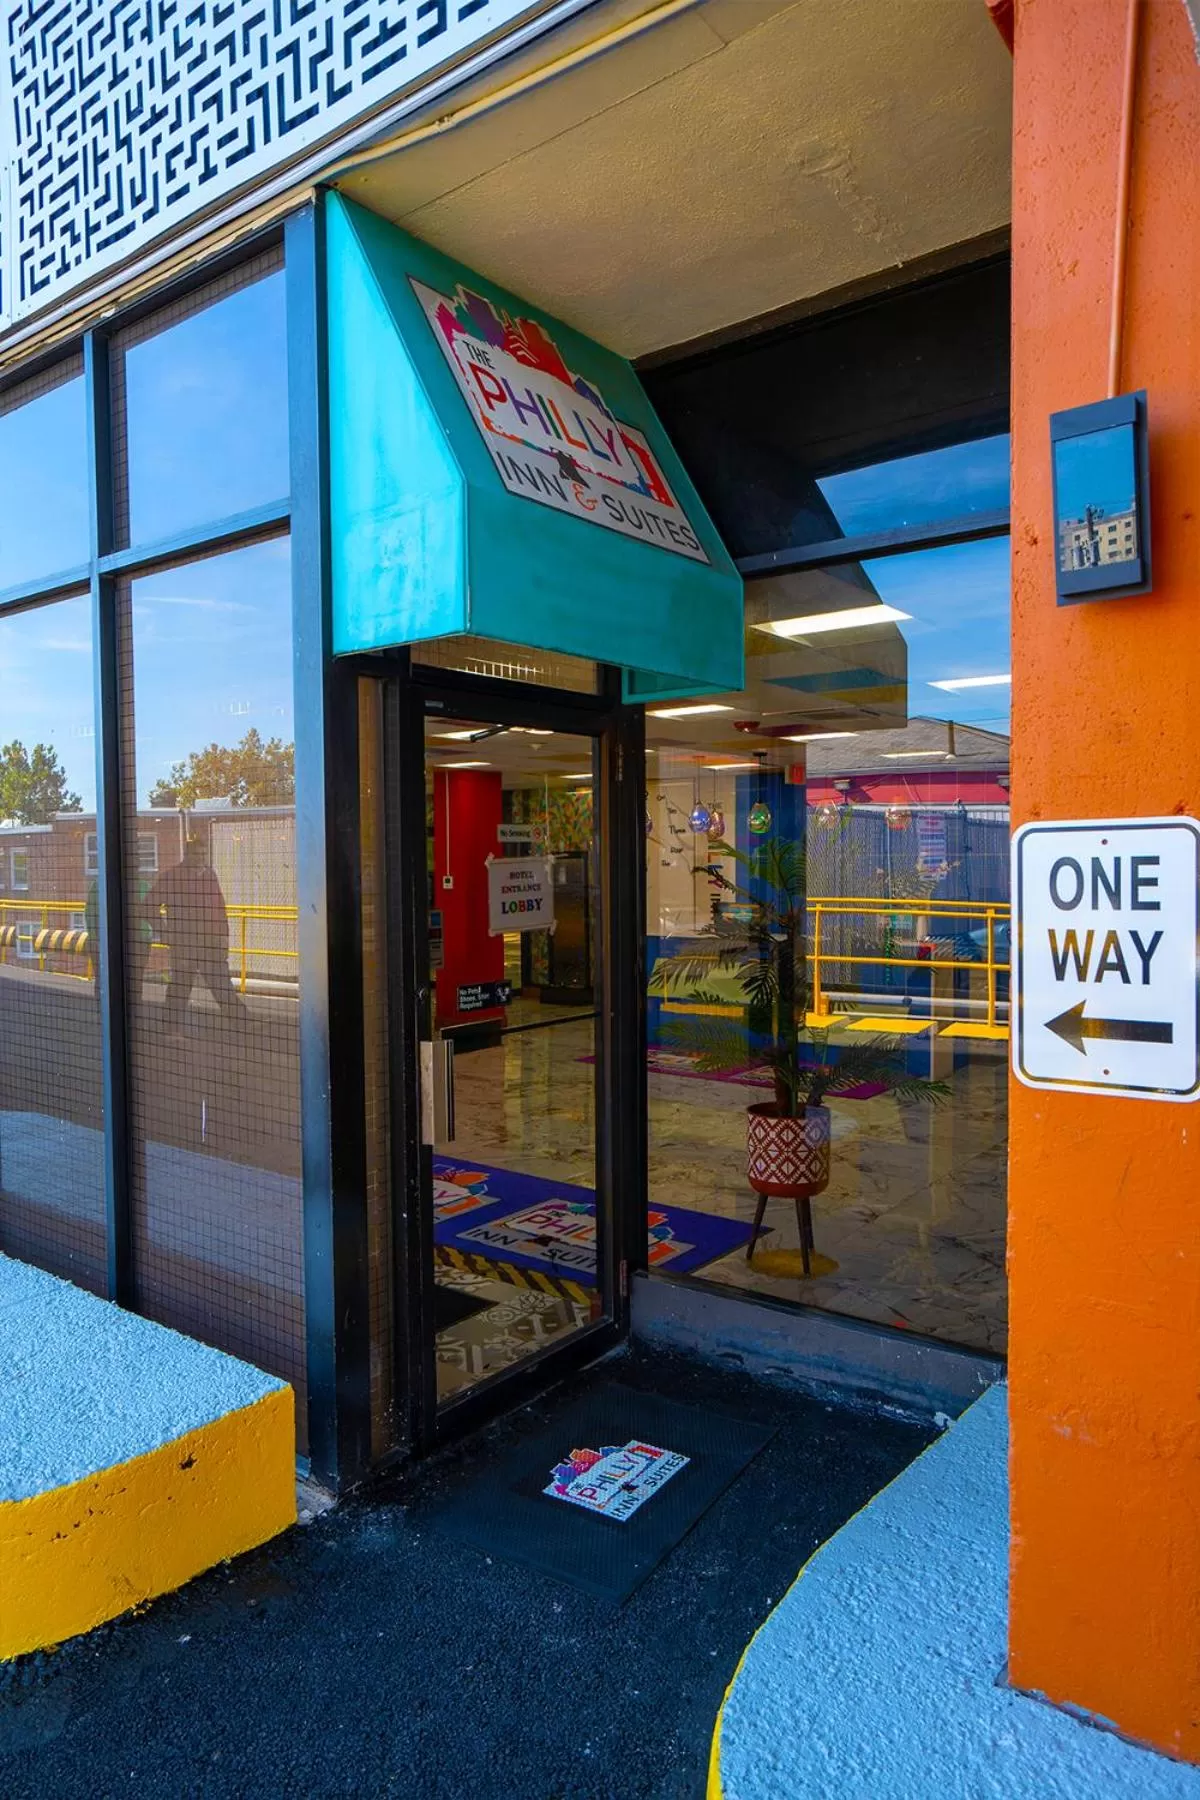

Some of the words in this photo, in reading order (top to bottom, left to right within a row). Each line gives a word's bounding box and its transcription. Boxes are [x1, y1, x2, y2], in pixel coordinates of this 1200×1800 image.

[462, 340, 496, 369] THE
[467, 361, 623, 467] PHILLY
[496, 451, 569, 503] INN
[602, 494, 700, 550] SUITES
[501, 883, 541, 895] ENTRANCE
[509, 870, 535, 880] HOTEL
[1050, 855, 1161, 911] ONE
[501, 898, 543, 914] LOBBY
[1047, 928, 1164, 985] WAY
[467, 1229, 518, 1245] INN
[517, 1214, 596, 1241] PHIL
[577, 1453, 640, 1500] PHILLY
[611, 1492, 638, 1517] INN
[644, 1454, 685, 1487] SUITES
